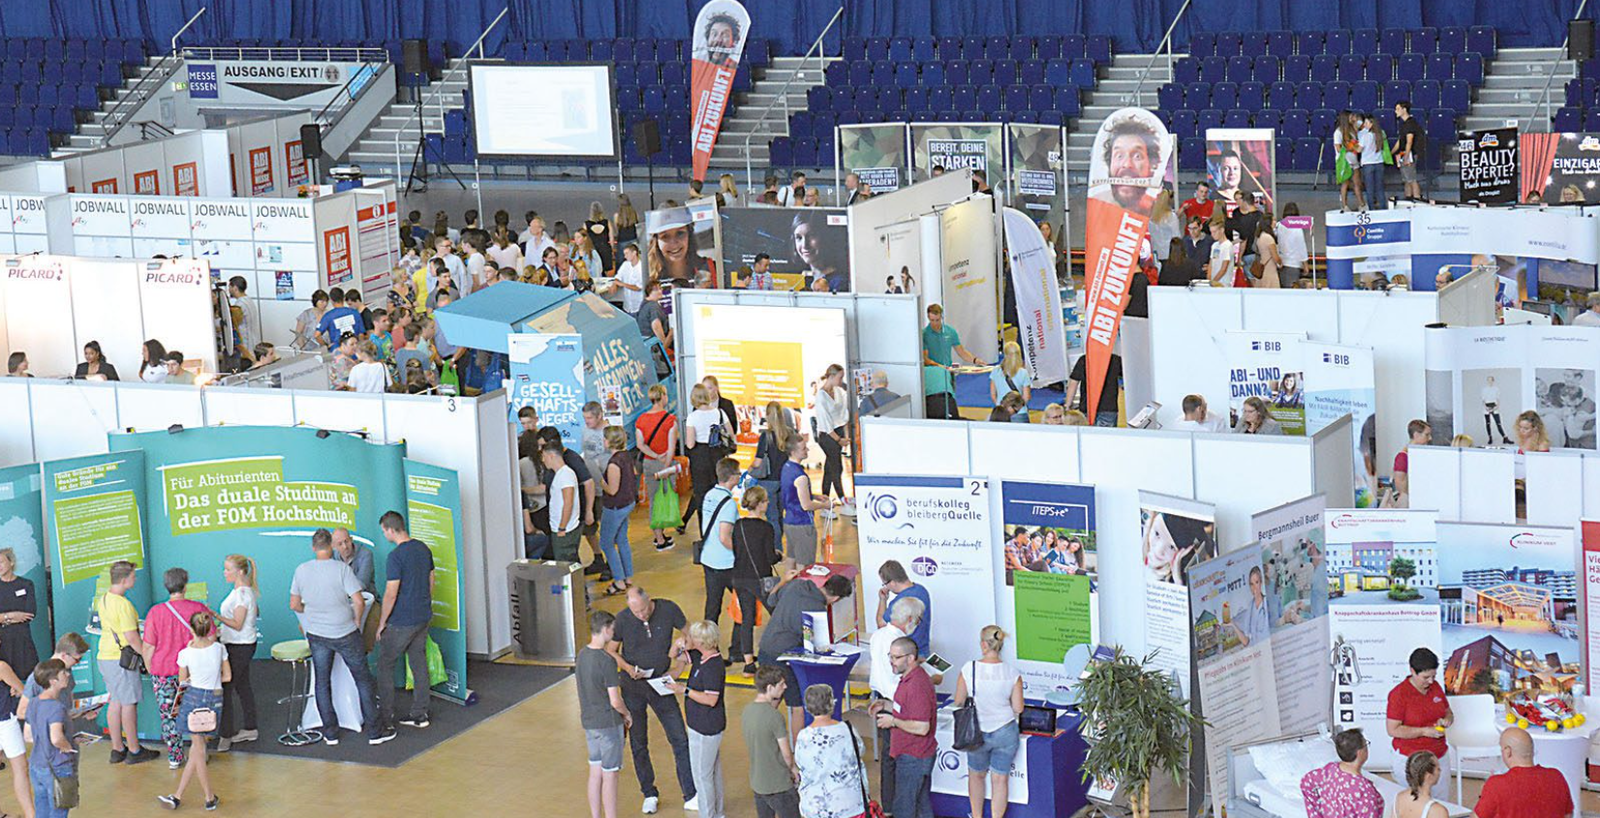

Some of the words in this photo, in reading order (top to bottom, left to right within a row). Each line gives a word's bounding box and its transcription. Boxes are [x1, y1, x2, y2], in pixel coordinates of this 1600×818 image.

[189, 71, 216, 81] MESSE
[190, 81, 217, 92] ESSEN
[703, 67, 732, 128] ZUKUNFT
[695, 127, 716, 154] ABI
[1460, 141, 1474, 150] 46
[930, 143, 959, 155] BEREIT,
[961, 143, 985, 154] DEINE
[254, 152, 269, 169] ABI
[931, 152, 985, 173] STÄRKEN
[1461, 148, 1516, 168] BEAUTY
[178, 167, 194, 184] ABI
[1461, 162, 1515, 181] EXPERTE?
[74, 200, 126, 214] JOBWALL
[133, 202, 185, 216] JOBWALL
[194, 203, 247, 217] JOBWALL
[255, 204, 309, 219] JOBWALL
[1357, 213, 1371, 225] 35
[329, 232, 347, 254] ABI
[1100, 211, 1144, 307] ZUKUNFT
[7, 268, 55, 282] PICARD
[145, 272, 194, 285] PICARD
[1033, 309, 1046, 350] national
[1089, 304, 1119, 347] ABI
[1264, 341, 1282, 352] BIB
[1334, 354, 1350, 366] BIB
[1230, 369, 1248, 383] ABI
[1257, 367, 1281, 381] UND
[1230, 383, 1269, 400] DANN?
[448, 398, 457, 413] 3
[170, 477, 194, 493] Für
[199, 470, 280, 488] Abiturienten
[970, 481, 981, 496] 2
[173, 493, 211, 510] Das
[216, 485, 271, 506] duale
[274, 484, 340, 504] Studium
[341, 491, 358, 507] an
[906, 498, 970, 512] berufskolleg
[177, 511, 211, 530] der
[216, 506, 258, 526] FOM
[261, 505, 354, 526] Hochschule.
[907, 510, 982, 523] bleibergQuelle
[1305, 512, 1320, 525] Buer
[1227, 578, 1243, 593] POTT
[512, 592, 522, 644] Abfall
[1400, 610, 1420, 618] Bottrop
